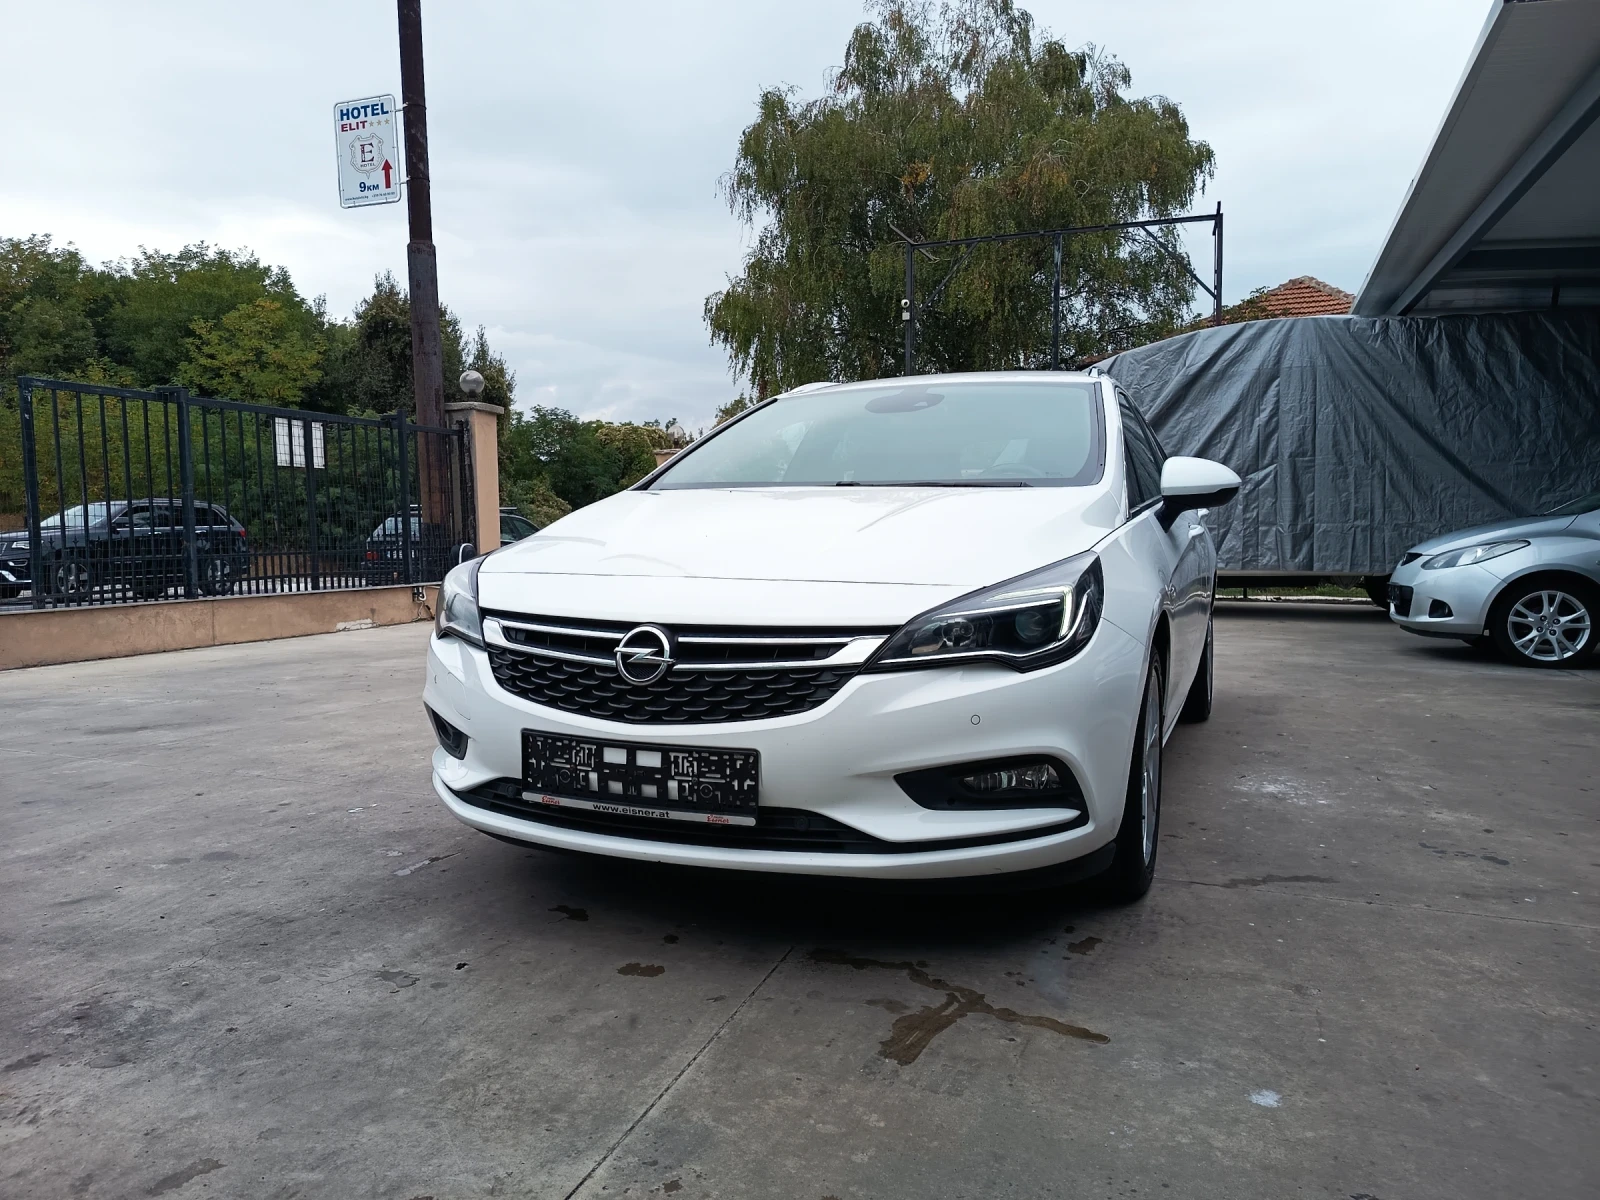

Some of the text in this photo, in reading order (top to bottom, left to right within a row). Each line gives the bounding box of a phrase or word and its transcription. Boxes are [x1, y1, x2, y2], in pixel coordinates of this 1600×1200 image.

[340, 103, 389, 121] HOTEL
[341, 121, 367, 132] ELIT
[360, 142, 374, 162] E
[593, 803, 670, 818] www.eisner.at
